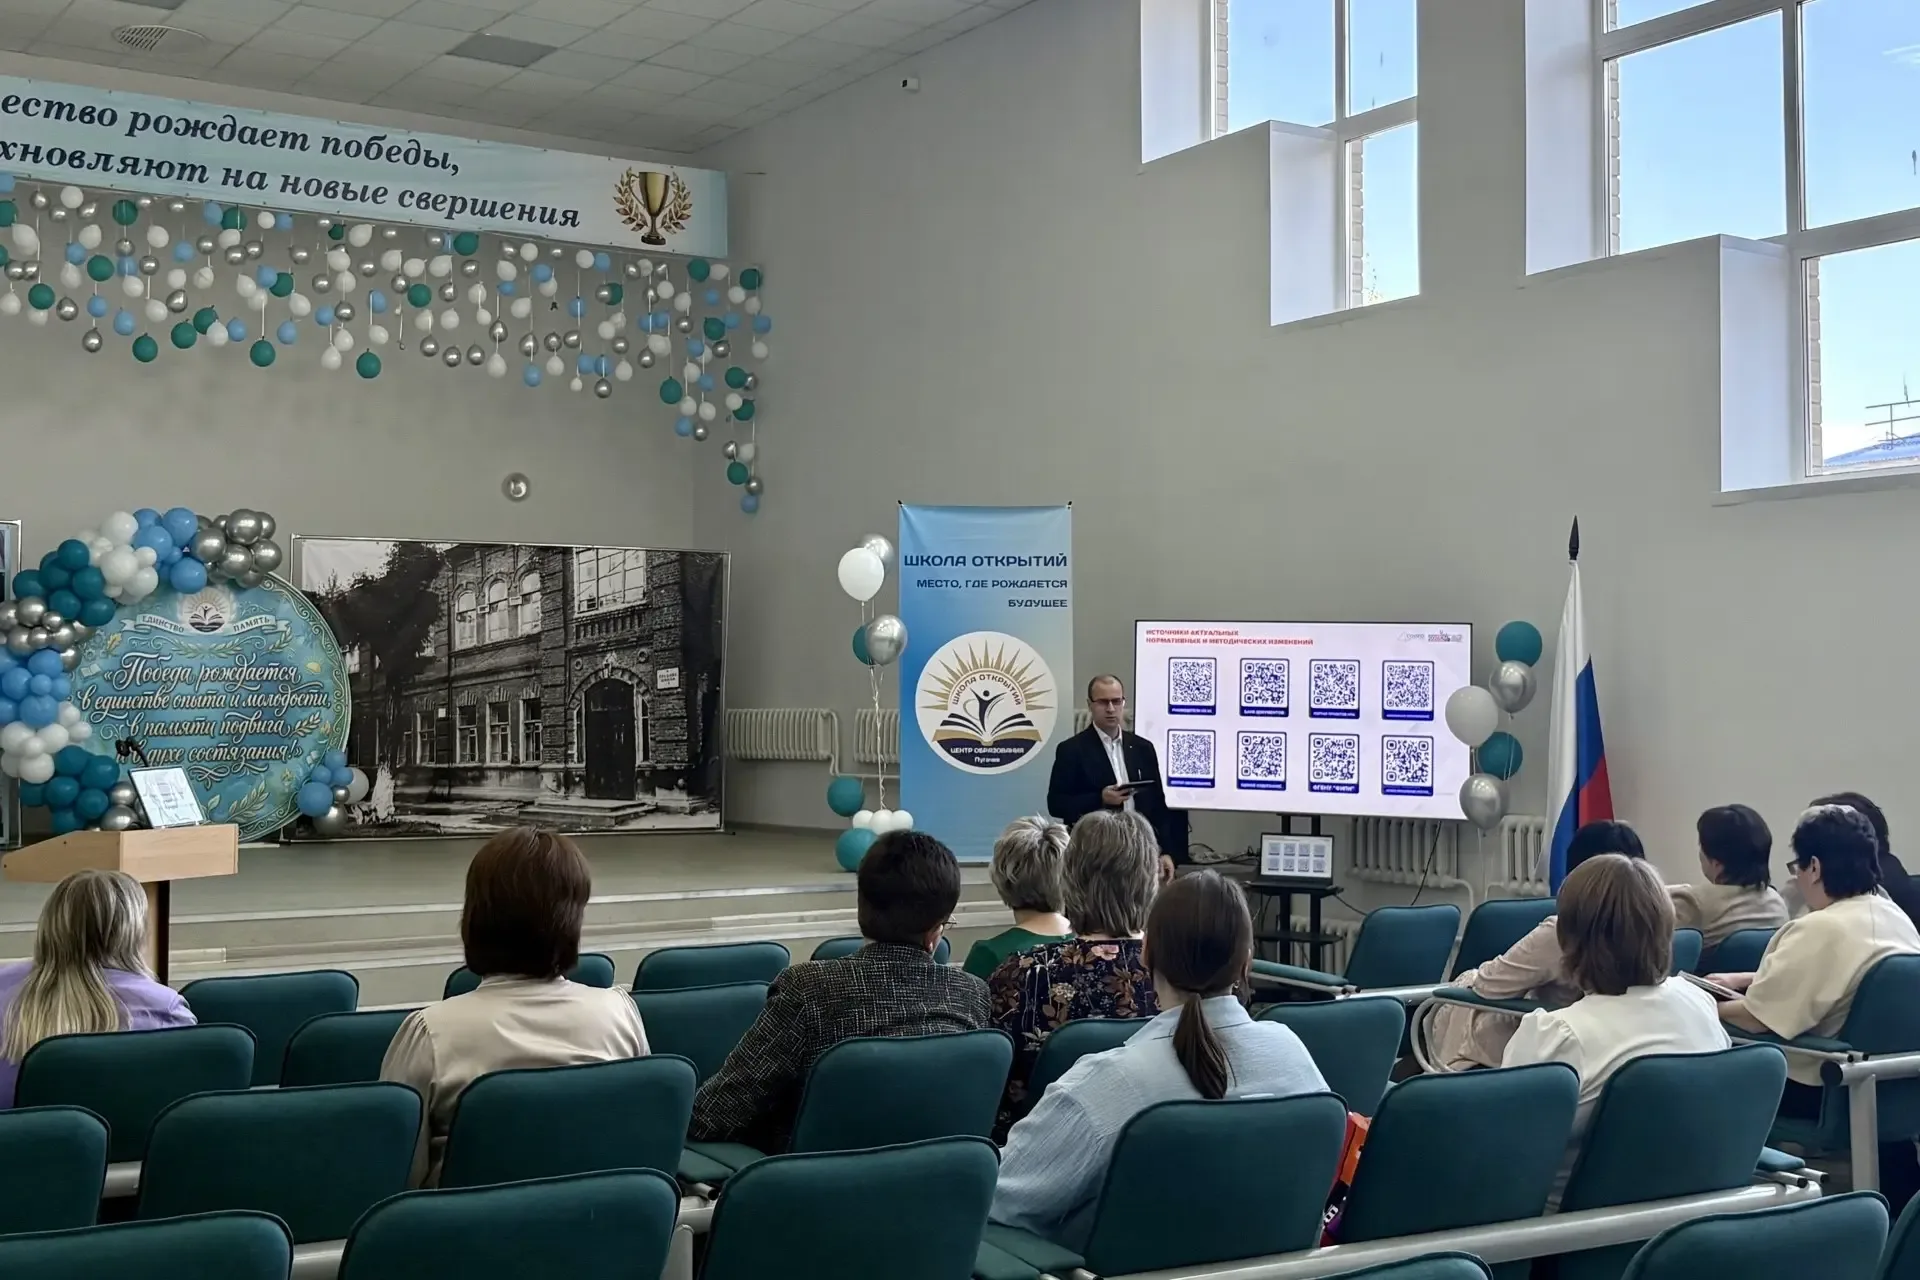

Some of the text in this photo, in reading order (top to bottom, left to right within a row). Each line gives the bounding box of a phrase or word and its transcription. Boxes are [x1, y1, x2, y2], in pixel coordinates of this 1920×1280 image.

[125, 111, 310, 152] рождает
[321, 134, 459, 176] победы,
[0, 140, 580, 228] хновляют на новые свершения
[904, 553, 1067, 567] ШКОЛА ОТКРЫТИЙ
[916, 579, 1068, 589] МЕСТО, ГДЕ РОЖДАЕТСЯ
[142, 615, 270, 633] ЕДИНСТВО ПАМЯТЬ
[104, 652, 301, 692] «Победа рождается
[77, 681, 331, 723] в единстве опыта и молодости,
[952, 673, 1022, 706] ШКОЛА ОТКРЫТИЙ
[126, 710, 291, 744] в памяти подвига
[146, 748, 185, 767] духе
